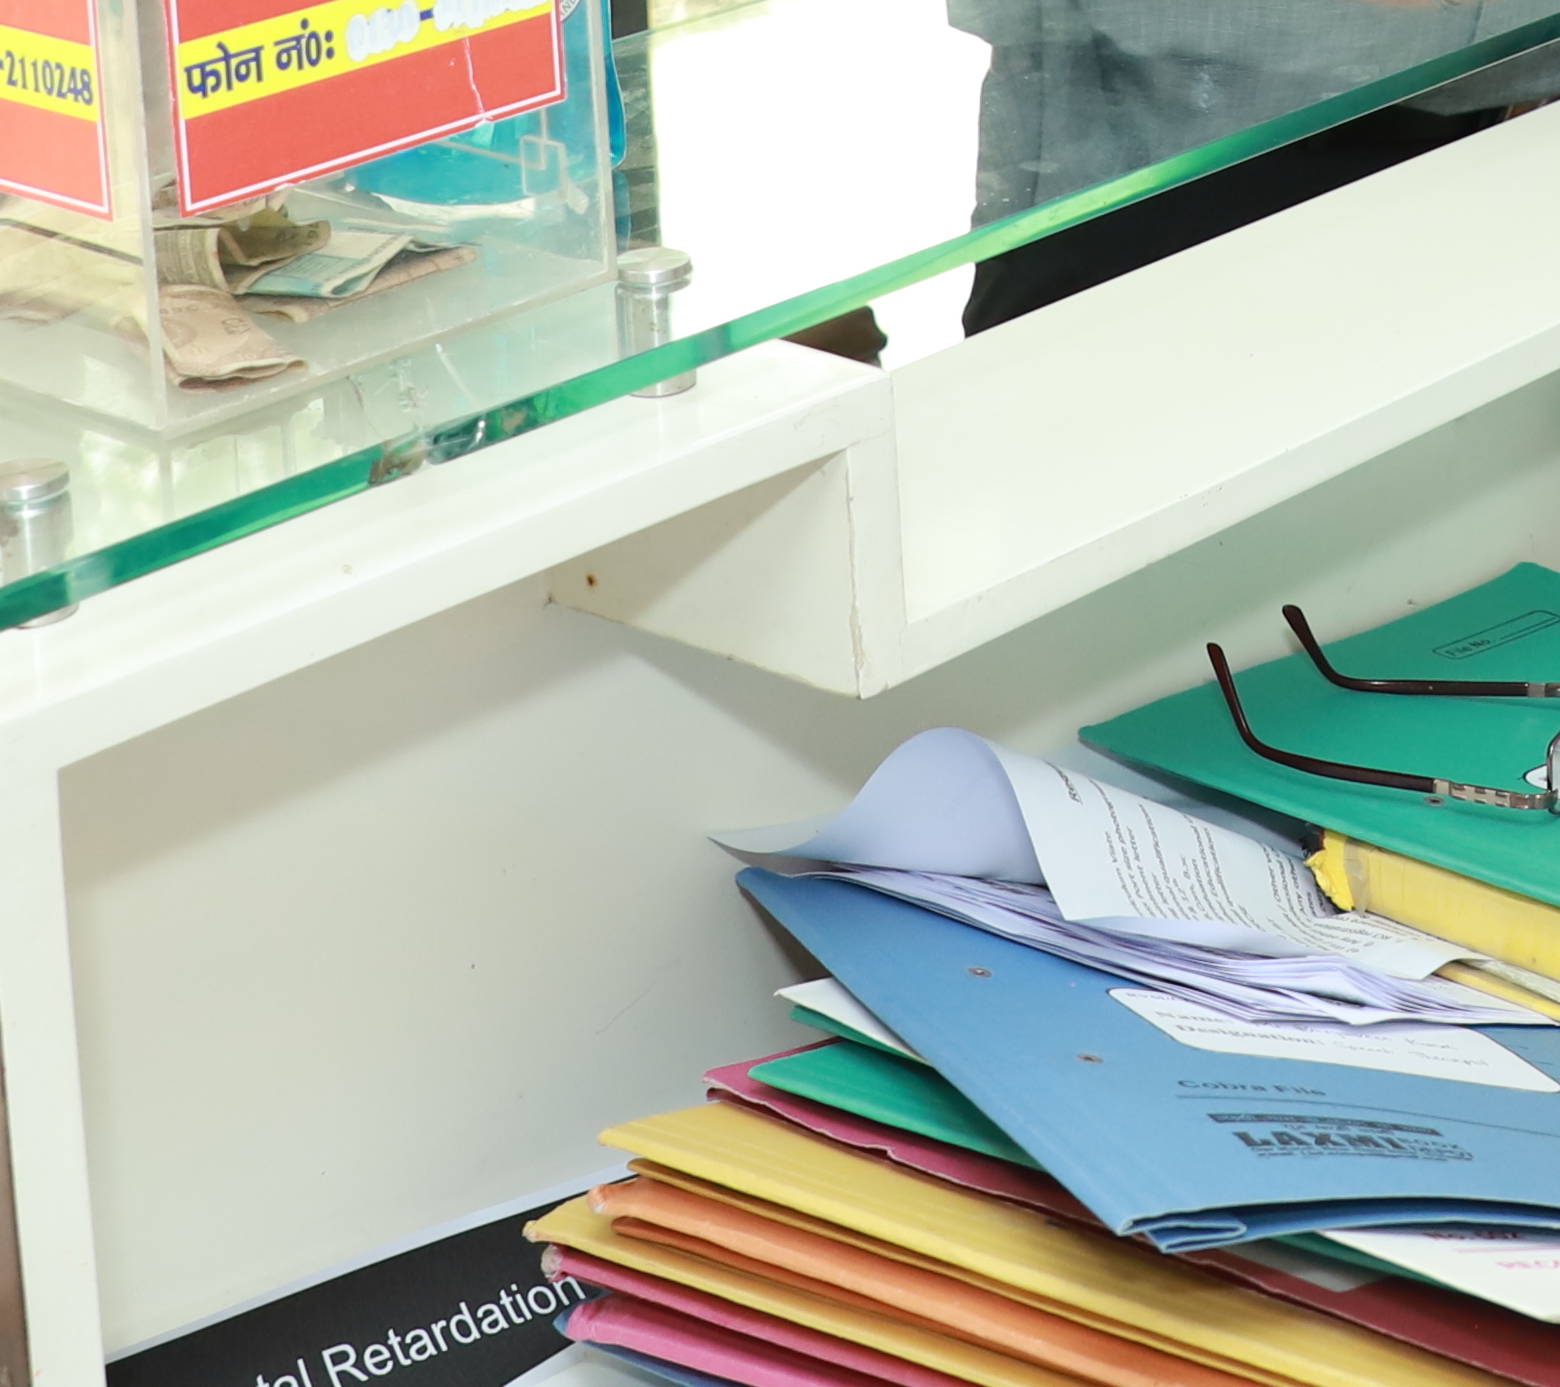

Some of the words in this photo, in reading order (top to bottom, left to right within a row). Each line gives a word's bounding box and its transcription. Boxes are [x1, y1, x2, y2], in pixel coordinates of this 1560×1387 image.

[184, 40, 265, 100] फोन
[1176, 1023, 1326, 1046] Designation:
[1176, 1079, 1268, 1093] Cobra
[1232, 1130, 1408, 1151] LAXMI
[320, 1275, 588, 1387] Retardation
